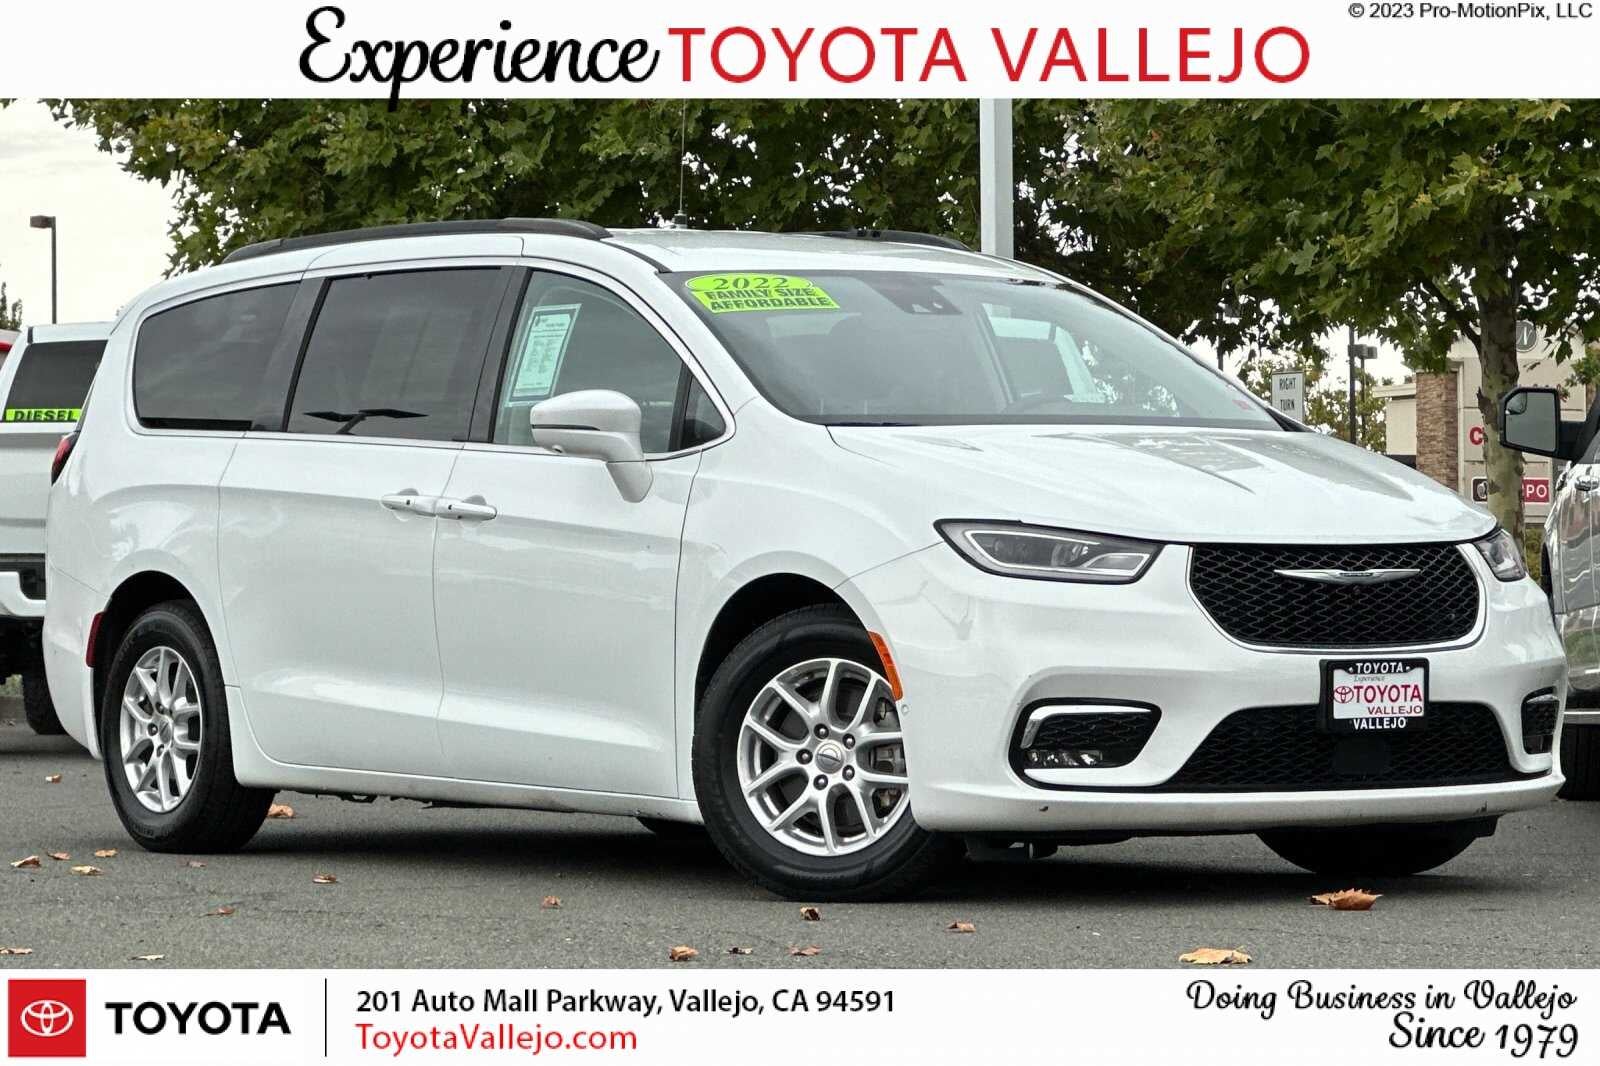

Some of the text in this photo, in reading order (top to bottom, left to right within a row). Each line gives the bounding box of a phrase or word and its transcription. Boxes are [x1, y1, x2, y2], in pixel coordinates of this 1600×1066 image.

[713, 277, 789, 289] 2022
[704, 287, 818, 299] FAMILY SIZE
[711, 297, 829, 310] AFFORDABLE
[1279, 377, 1296, 390] RIGHT
[1280, 399, 1295, 411] TURN
[14, 410, 77, 421] DIESEL
[1356, 662, 1403, 674] TOYOTA
[1353, 684, 1422, 703] TOYOTA
[1367, 705, 1423, 715] VALLEJO
[1353, 717, 1406, 730] VALLEJO
